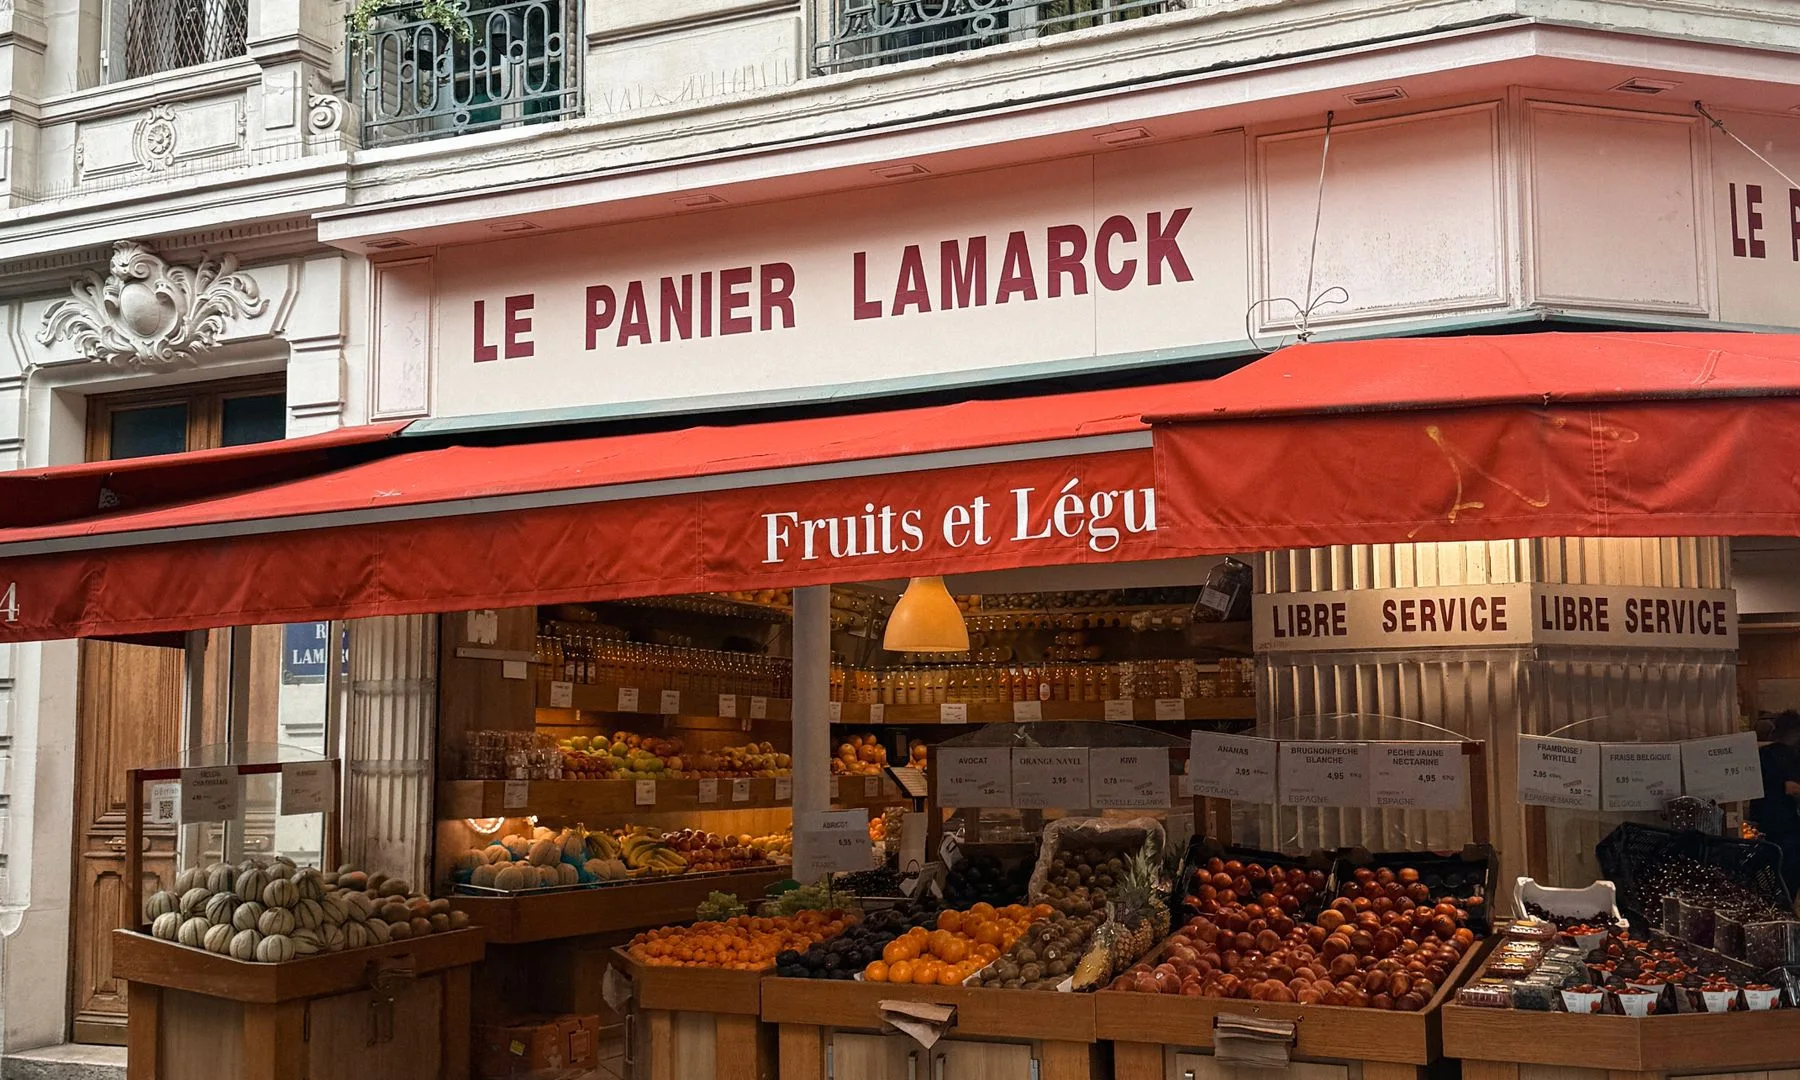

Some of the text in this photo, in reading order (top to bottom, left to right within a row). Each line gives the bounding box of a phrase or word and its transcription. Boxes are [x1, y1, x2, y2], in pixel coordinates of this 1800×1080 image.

[1729, 182, 1766, 259] LE
[473, 207, 1194, 364] LE PANIER LAMARCK
[761, 477, 1158, 564] Fruits et Légu
[1272, 596, 1508, 638] LIBRE SERVICE
[1540, 595, 1728, 636] LIBRE SERVICE
[1217, 745, 1249, 756] ANANAS
[1416, 749, 1445, 757] JAUNE
[1537, 743, 1579, 755] FRAMBOISE
[958, 757, 988, 765] AVOCAT
[1119, 757, 1138, 765] KIWI
[1305, 756, 1344, 764] BLANCHE
[1392, 758, 1439, 766] NECTARINE
[1542, 753, 1577, 764] MYRTILLE
[1610, 753, 1672, 761] FRAISE BELGIQUE
[1327, 772, 1344, 781] 4,95
[1418, 774, 1437, 783] 4,95
